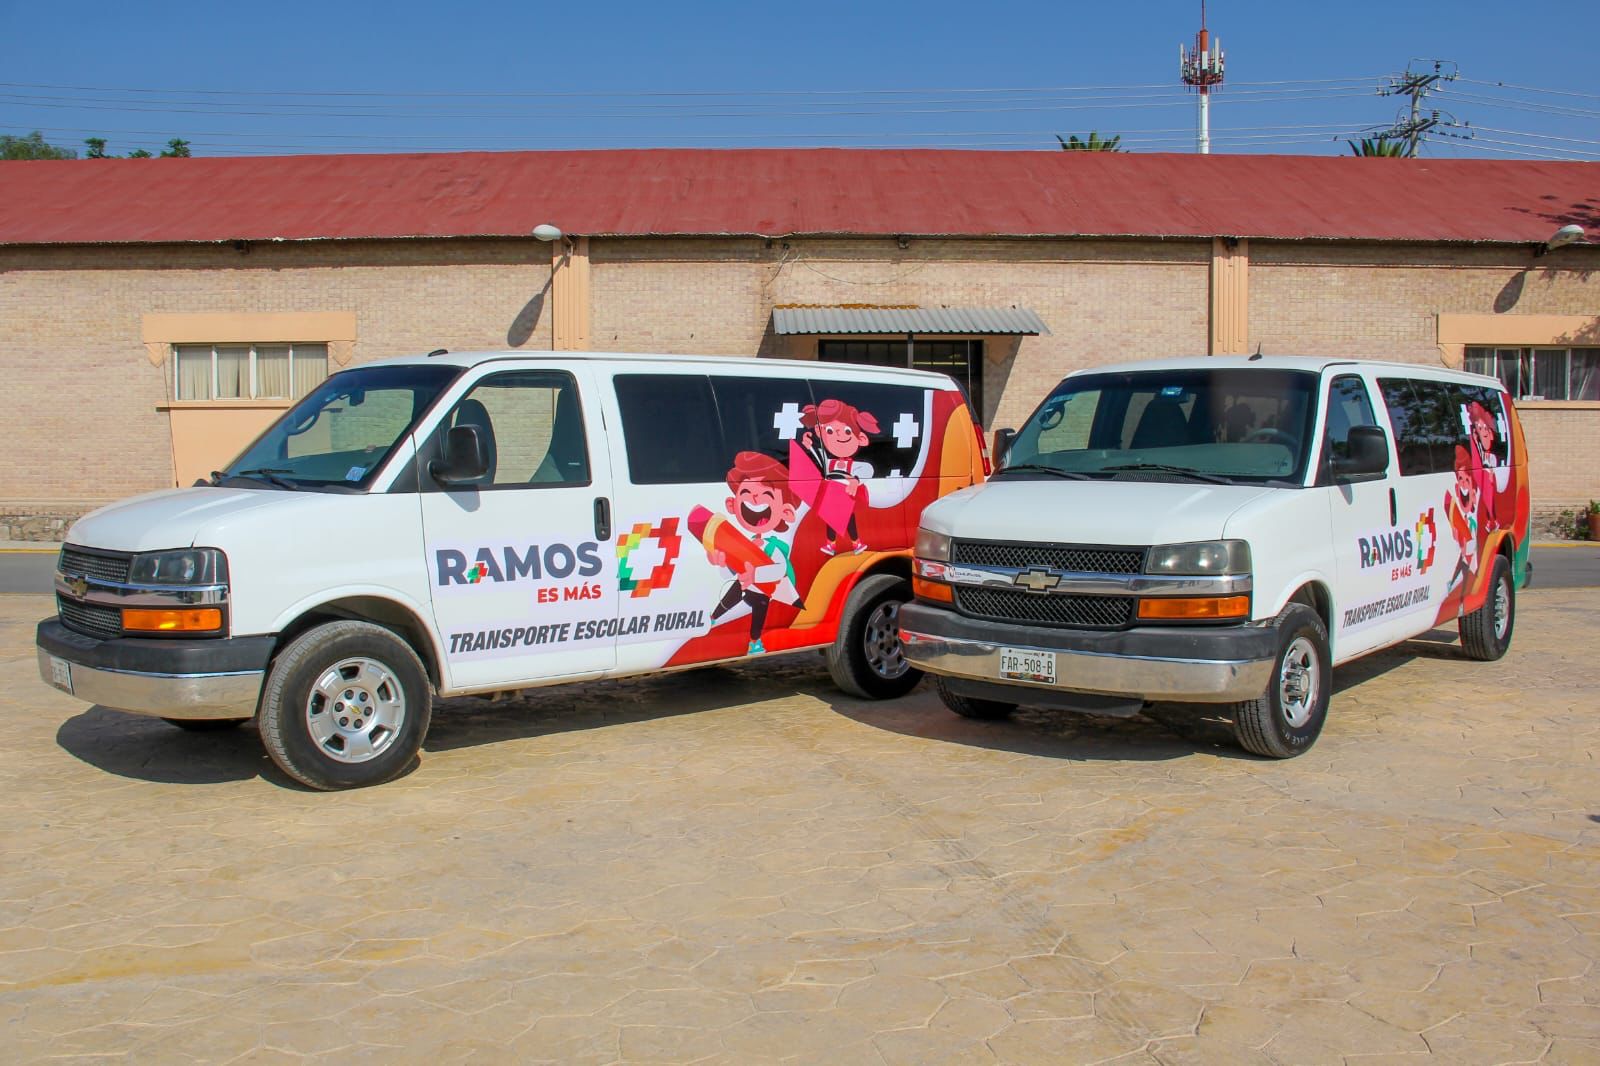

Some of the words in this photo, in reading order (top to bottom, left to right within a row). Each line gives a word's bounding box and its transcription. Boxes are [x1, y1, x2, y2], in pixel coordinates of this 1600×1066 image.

[436, 541, 603, 586] RAMOS
[1358, 529, 1413, 569] RAMOS
[537, 587, 559, 603] ES
[563, 581, 602, 601] MÁS
[1391, 568, 1399, 581] ES
[1342, 599, 1387, 629] TRANSPORTE
[1385, 590, 1413, 614] ESCOLAR
[1412, 584, 1430, 605] RURAL
[450, 623, 570, 654] TRANSPORTE
[573, 615, 651, 640] ESCOLAR
[653, 610, 705, 633] RURAL
